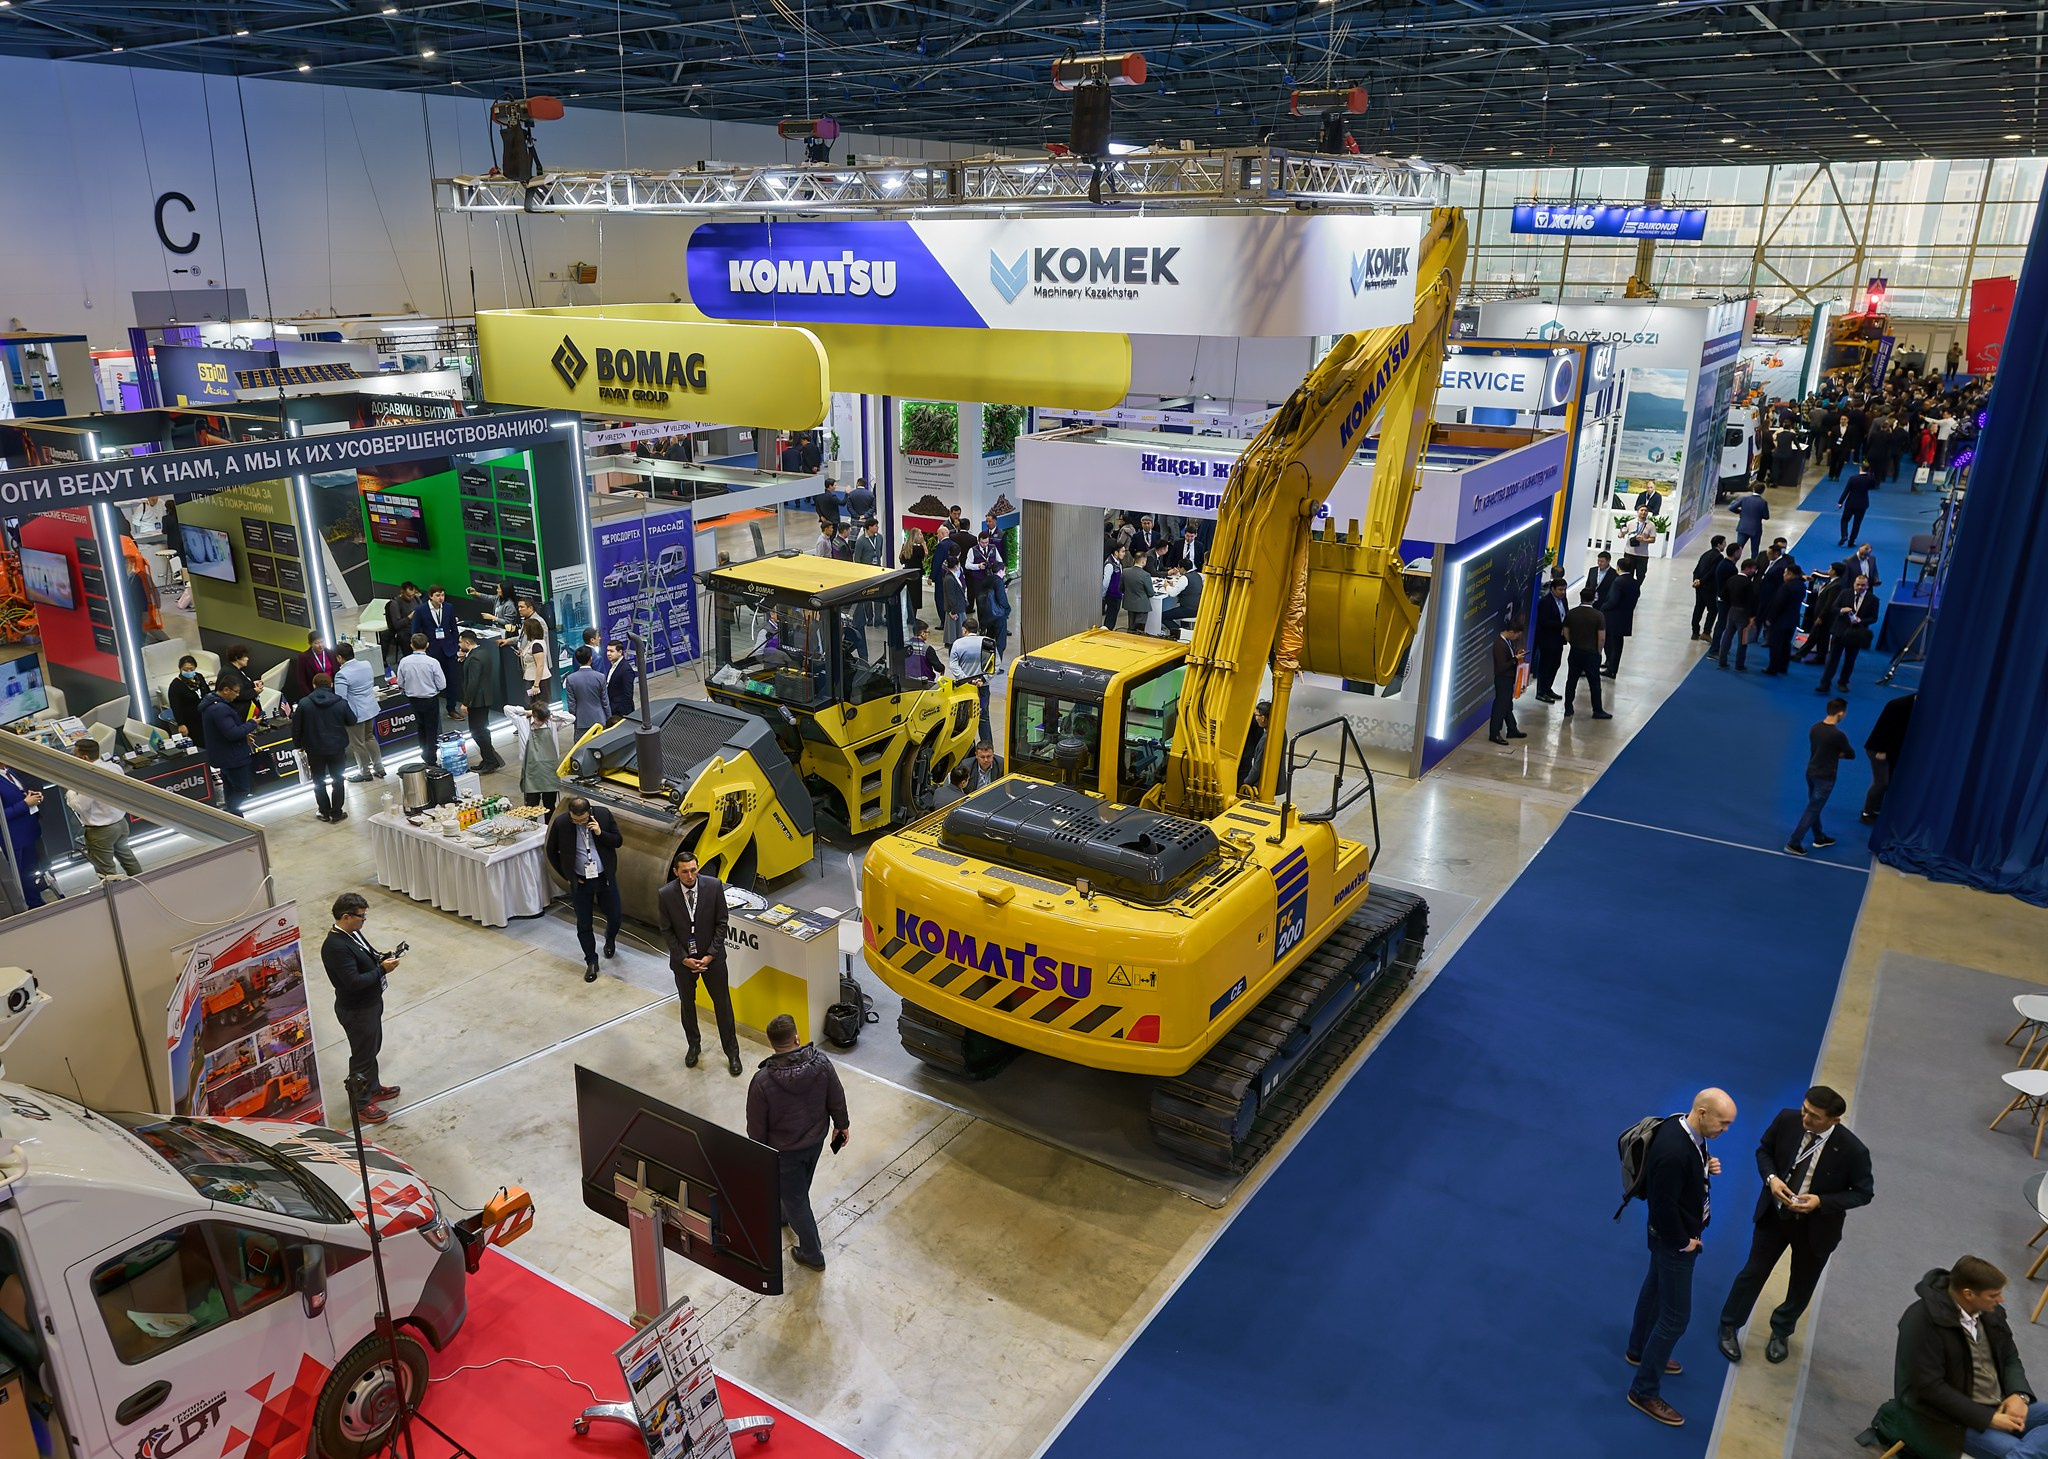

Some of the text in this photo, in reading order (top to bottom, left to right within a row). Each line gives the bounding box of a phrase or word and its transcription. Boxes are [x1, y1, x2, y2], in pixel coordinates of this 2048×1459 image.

[154, 191, 201, 255] C
[1548, 214, 1595, 230] XCMG
[1637, 222, 1679, 231] BAIKONUR
[1034, 246, 1180, 285] KOMEK
[1365, 247, 1411, 279] KOMEK
[728, 250, 897, 297] KOMATSU
[1033, 286, 1139, 300] Machinery Kazakhstan
[595, 347, 708, 388] BOMAG
[1340, 329, 1411, 449] KOMATSU
[1442, 371, 1526, 392] ERVICE
[599, 387, 669, 403] FAYAT GROUP
[371, 401, 414, 417] ДОБАВКИ
[415, 405, 422, 417] В
[638, 428, 660, 436] VELETON
[670, 423, 691, 432] VELETON
[58, 468, 135, 497] ВЕДУТ
[140, 466, 159, 487] К
[162, 458, 220, 483] НАМ,
[225, 455, 240, 475] А
[244, 450, 281, 472] МЫ
[286, 447, 302, 466] К
[305, 443, 333, 464] ИХ
[335, 417, 550, 460] УСОВЕРШЕНСТВОВАНИЮ!
[1141, 453, 1207, 477] Жақсы
[239, 484, 261, 499] УХОДА
[262, 488, 273, 499] ЗА
[224, 498, 274, 515] ПОКРЫТИЯМИ
[610, 529, 640, 543] РОСДОРТЕХ
[755, 585, 775, 595] BOMAG
[390, 713, 416, 727] Unee
[392, 725, 406, 733] Group
[278, 760, 294, 768] Group
[162, 775, 205, 793] eedUs
[1333, 869, 1367, 907] KOMATSU
[1279, 908, 1294, 934] PC
[725, 925, 759, 951] MAG
[1276, 917, 1303, 958] 200
[896, 907, 1093, 1000] KOMATSU
[1229, 980, 1246, 1001] CE
